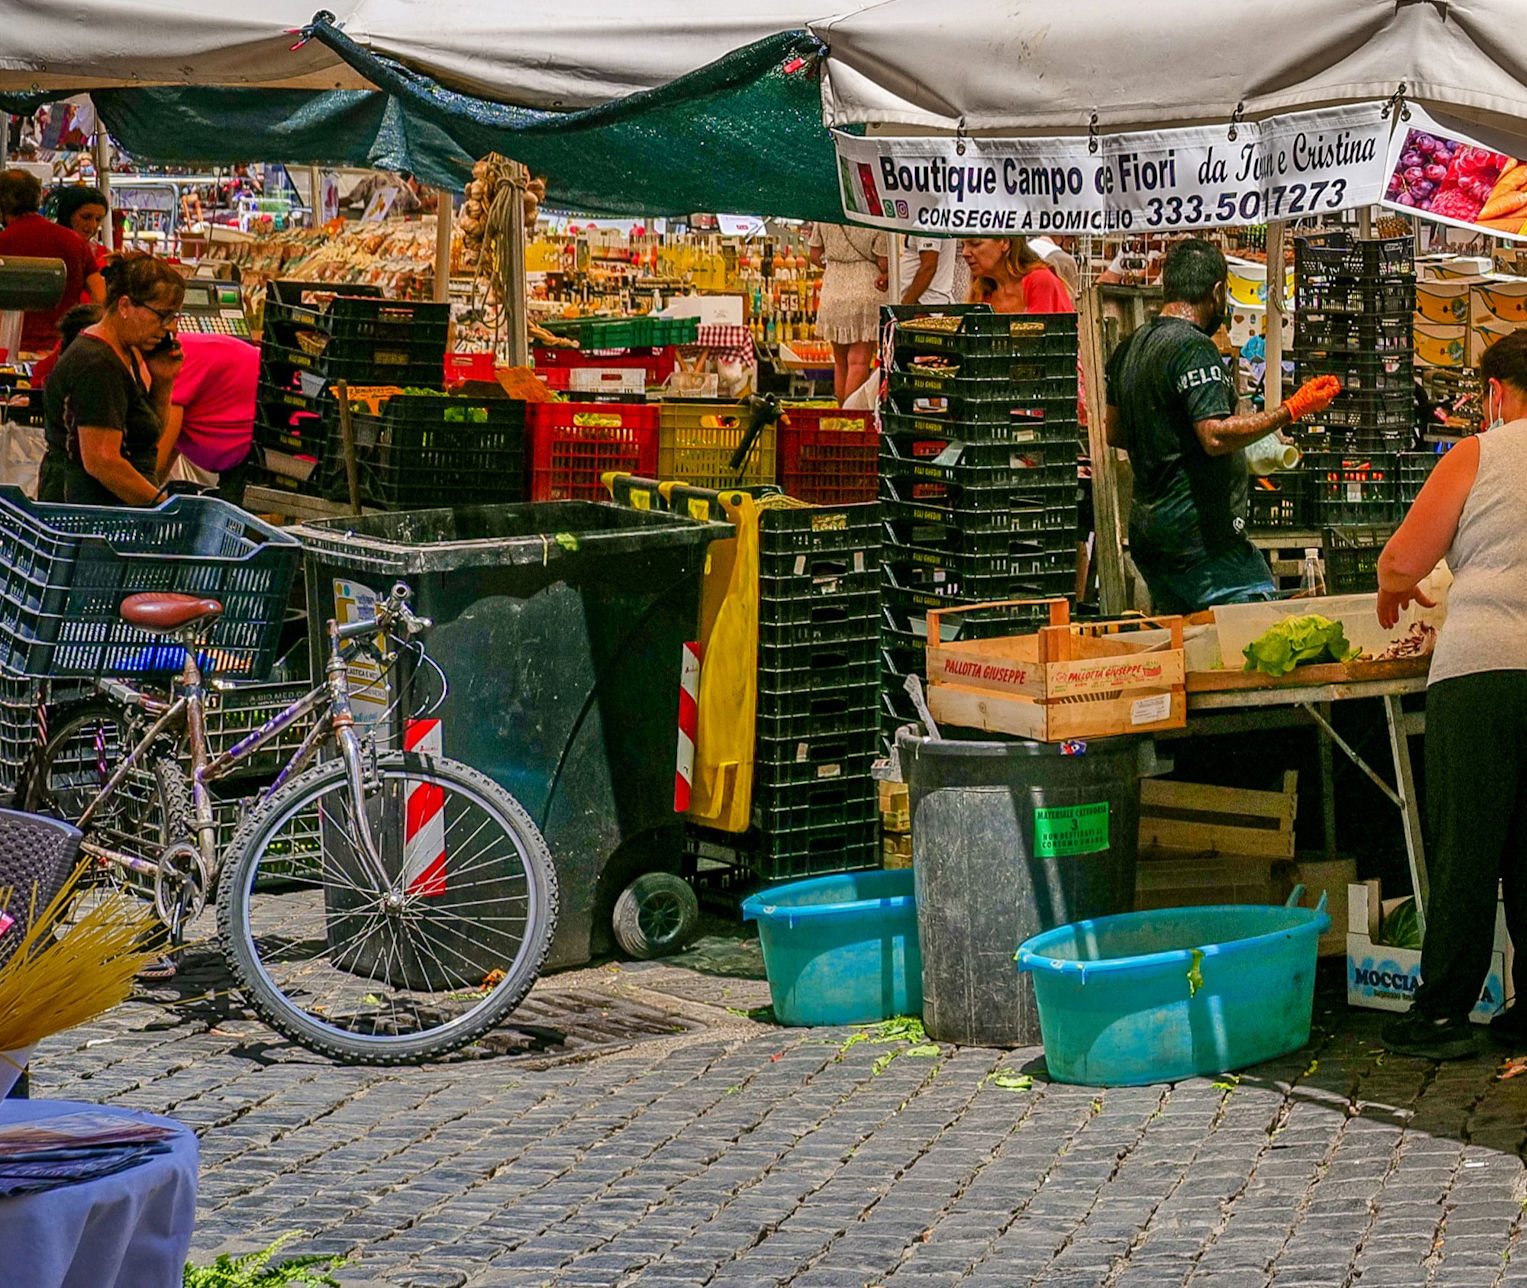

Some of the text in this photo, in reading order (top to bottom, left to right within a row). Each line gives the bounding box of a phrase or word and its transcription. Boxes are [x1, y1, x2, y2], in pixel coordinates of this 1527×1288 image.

[879, 156, 997, 203] Boutique
[1003, 157, 1084, 204] Campo
[1118, 149, 1177, 193] Fiori
[1198, 146, 1228, 186] da
[1278, 150, 1288, 175] e
[1292, 131, 1377, 173] Cristina
[918, 178, 1348, 230] CONSEGNE A DOMICILIO 333.5017273
[944, 659, 1027, 685] PALLOTTA GIUSEPPE
[1066, 664, 1144, 682] PALLOTTA GIUSEPPE
[1070, 818, 1079, 831] 3
[1355, 968, 1420, 992] MOCCIA
